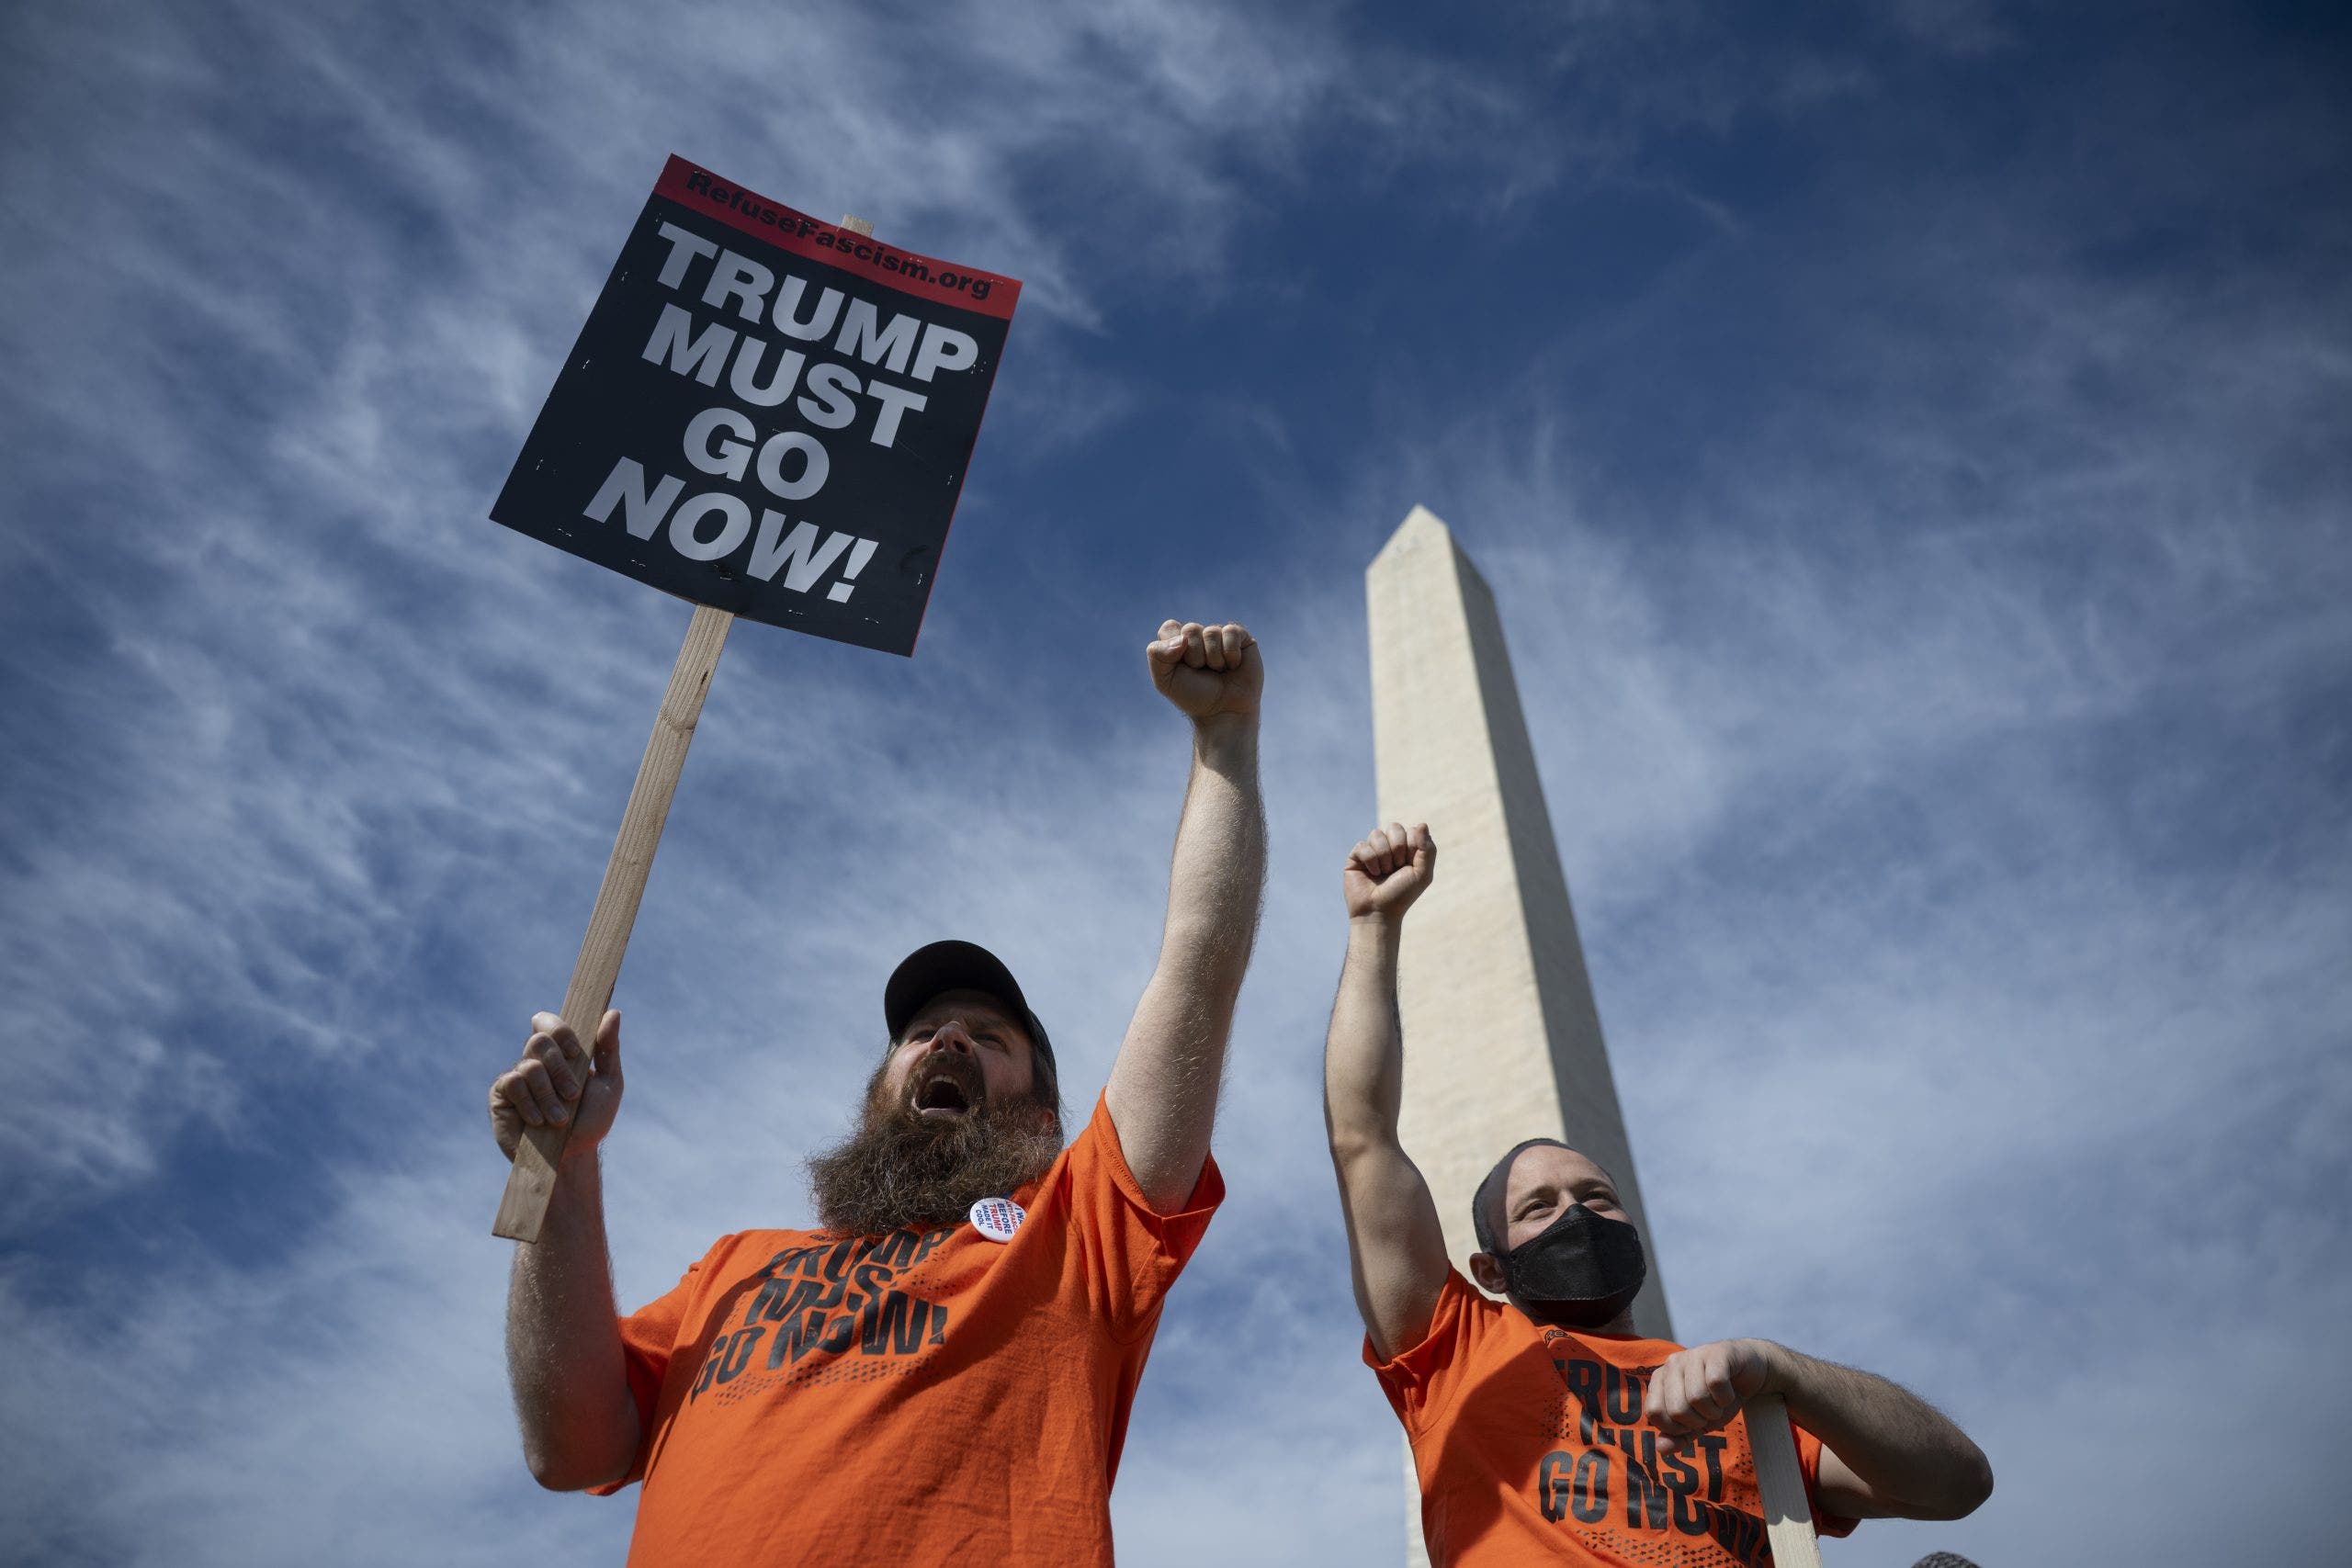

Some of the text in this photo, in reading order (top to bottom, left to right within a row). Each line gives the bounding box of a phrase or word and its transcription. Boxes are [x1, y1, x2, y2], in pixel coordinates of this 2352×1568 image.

[686, 171, 991, 300] RefuseFascism.org
[656, 220, 978, 383] TRUMP
[641, 302, 928, 448] MUST
[683, 407, 830, 501] GO
[582, 456, 879, 604] NOW!
[976, 1209, 984, 1226] COOL
[981, 1204, 991, 1221] MADE
[989, 1204, 1002, 1231] TRUMP
[997, 1203, 1012, 1234] BEFORE
[691, 1291, 948, 1405] GO NOW!
[1539, 1449, 1610, 1524] GO
